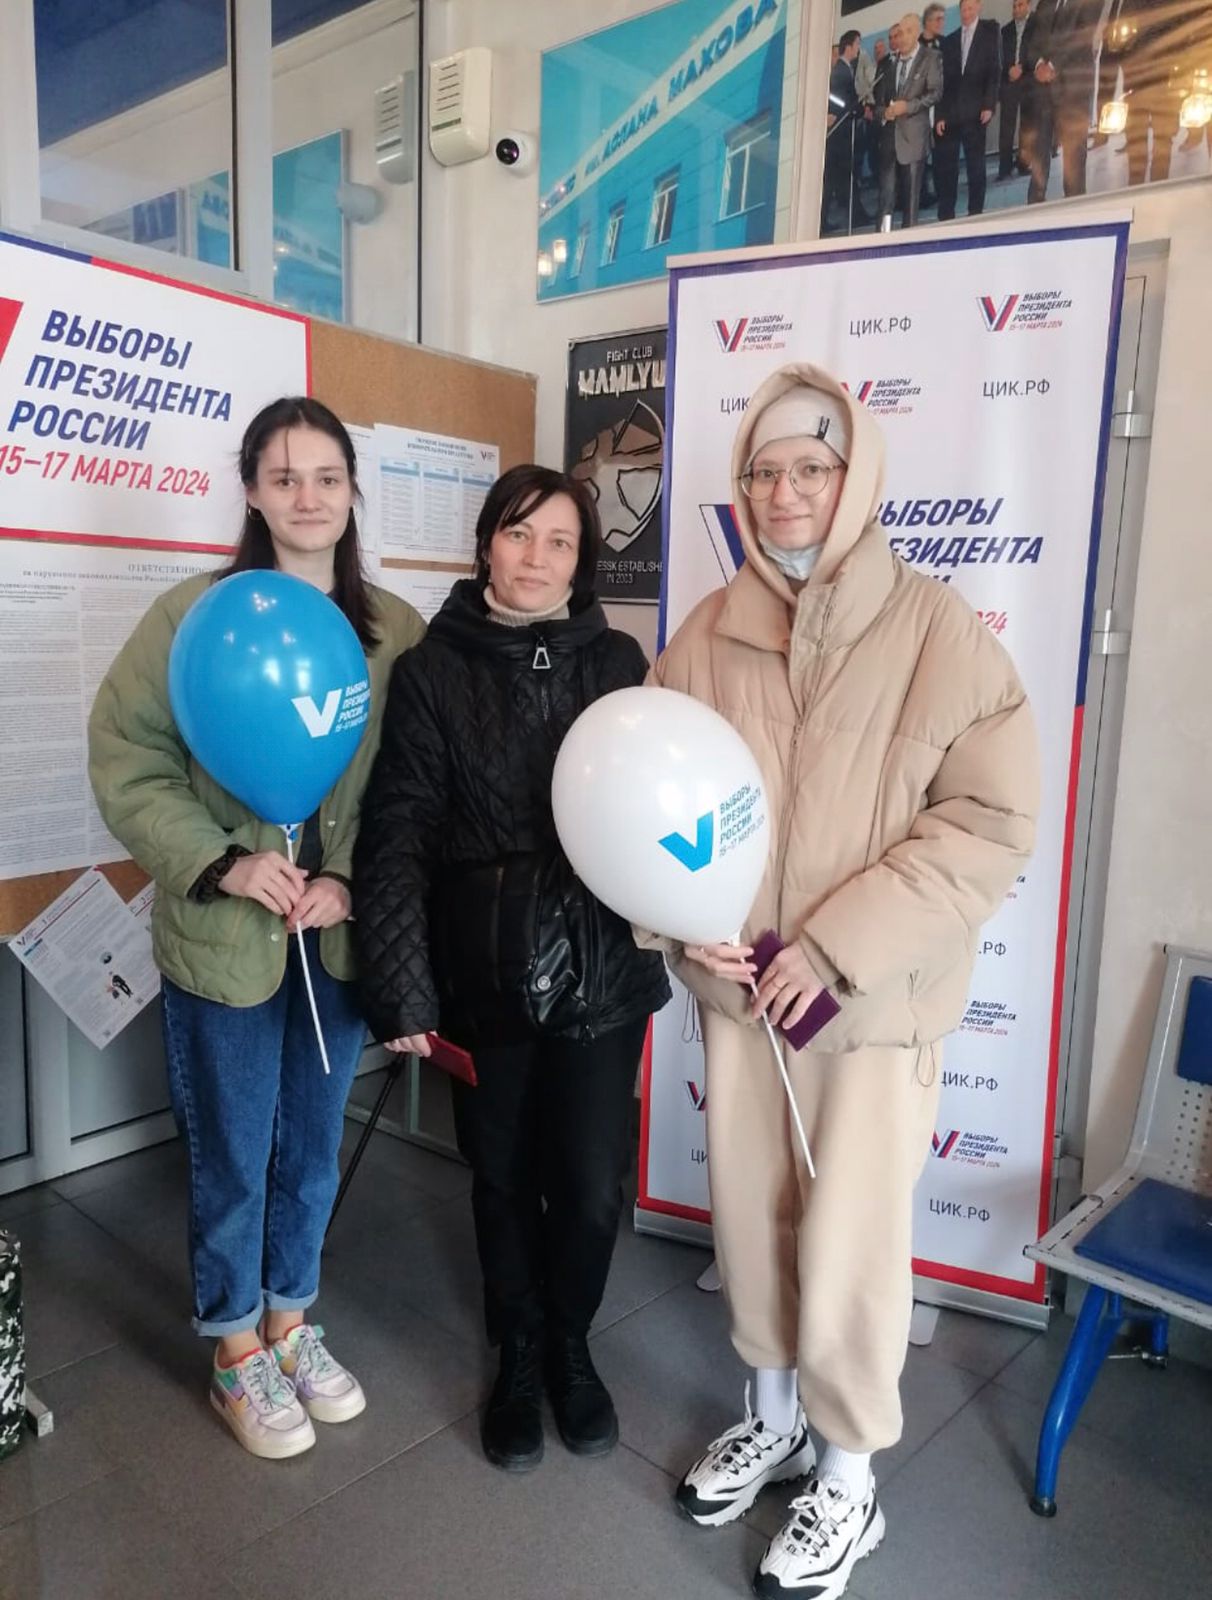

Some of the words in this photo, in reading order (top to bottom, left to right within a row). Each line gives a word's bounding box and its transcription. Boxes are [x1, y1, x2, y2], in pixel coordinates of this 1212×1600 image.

[1023, 291, 1061, 301] ВЫБОРЫ
[1018, 300, 1072, 312] ПРЕЗИДЕНТА
[752, 315, 784, 324] ВЫБОРЫ
[1013, 312, 1048, 322] РОССИИ
[747, 323, 793, 334] ПРЕЗИДЕНТА
[850, 316, 912, 338] ЦИК.РФ
[41, 309, 193, 370] ВЫБОРЫ
[744, 335, 772, 343] РОССИИ
[606, 349, 629, 363] FIGHT
[632, 346, 653, 359] CLUB
[24, 354, 232, 421] ПРЕЗИДЕНТА
[876, 379, 912, 388] ВЫБОРЫ
[983, 379, 1050, 399] ЦИК.РФ
[872, 387, 921, 397] ПРЕЗИДЕНТА
[721, 398, 750, 414] ЦИК
[867, 399, 899, 407] РОССИИ
[7, 400, 152, 451] РОССИИ
[71, 454, 153, 490] МАРТА
[157, 466, 210, 497] 2024
[889, 536, 1044, 568] ЕЗИДЕНТА
[597, 560, 617, 571] ESSK
[619, 560, 663, 572] ESTABLISHE
[720, 783, 751, 814] ВЫБОРЫ
[720, 813, 752, 845] РОССИИ
[978, 942, 1007, 956] .РФ
[971, 1001, 1007, 1010] ВЫБОРЫ
[966, 1009, 1016, 1020] ПРЕЗИДЕНТА
[961, 1017, 994, 1026] РОССИИ
[963, 1133, 998, 1143] ВЫБОРЫ
[954, 1148, 986, 1158] РОССИИ
[959, 1140, 1008, 1154] ПРЕЗИДЕНТА
[929, 1199, 991, 1222] ЦИК.РФ
